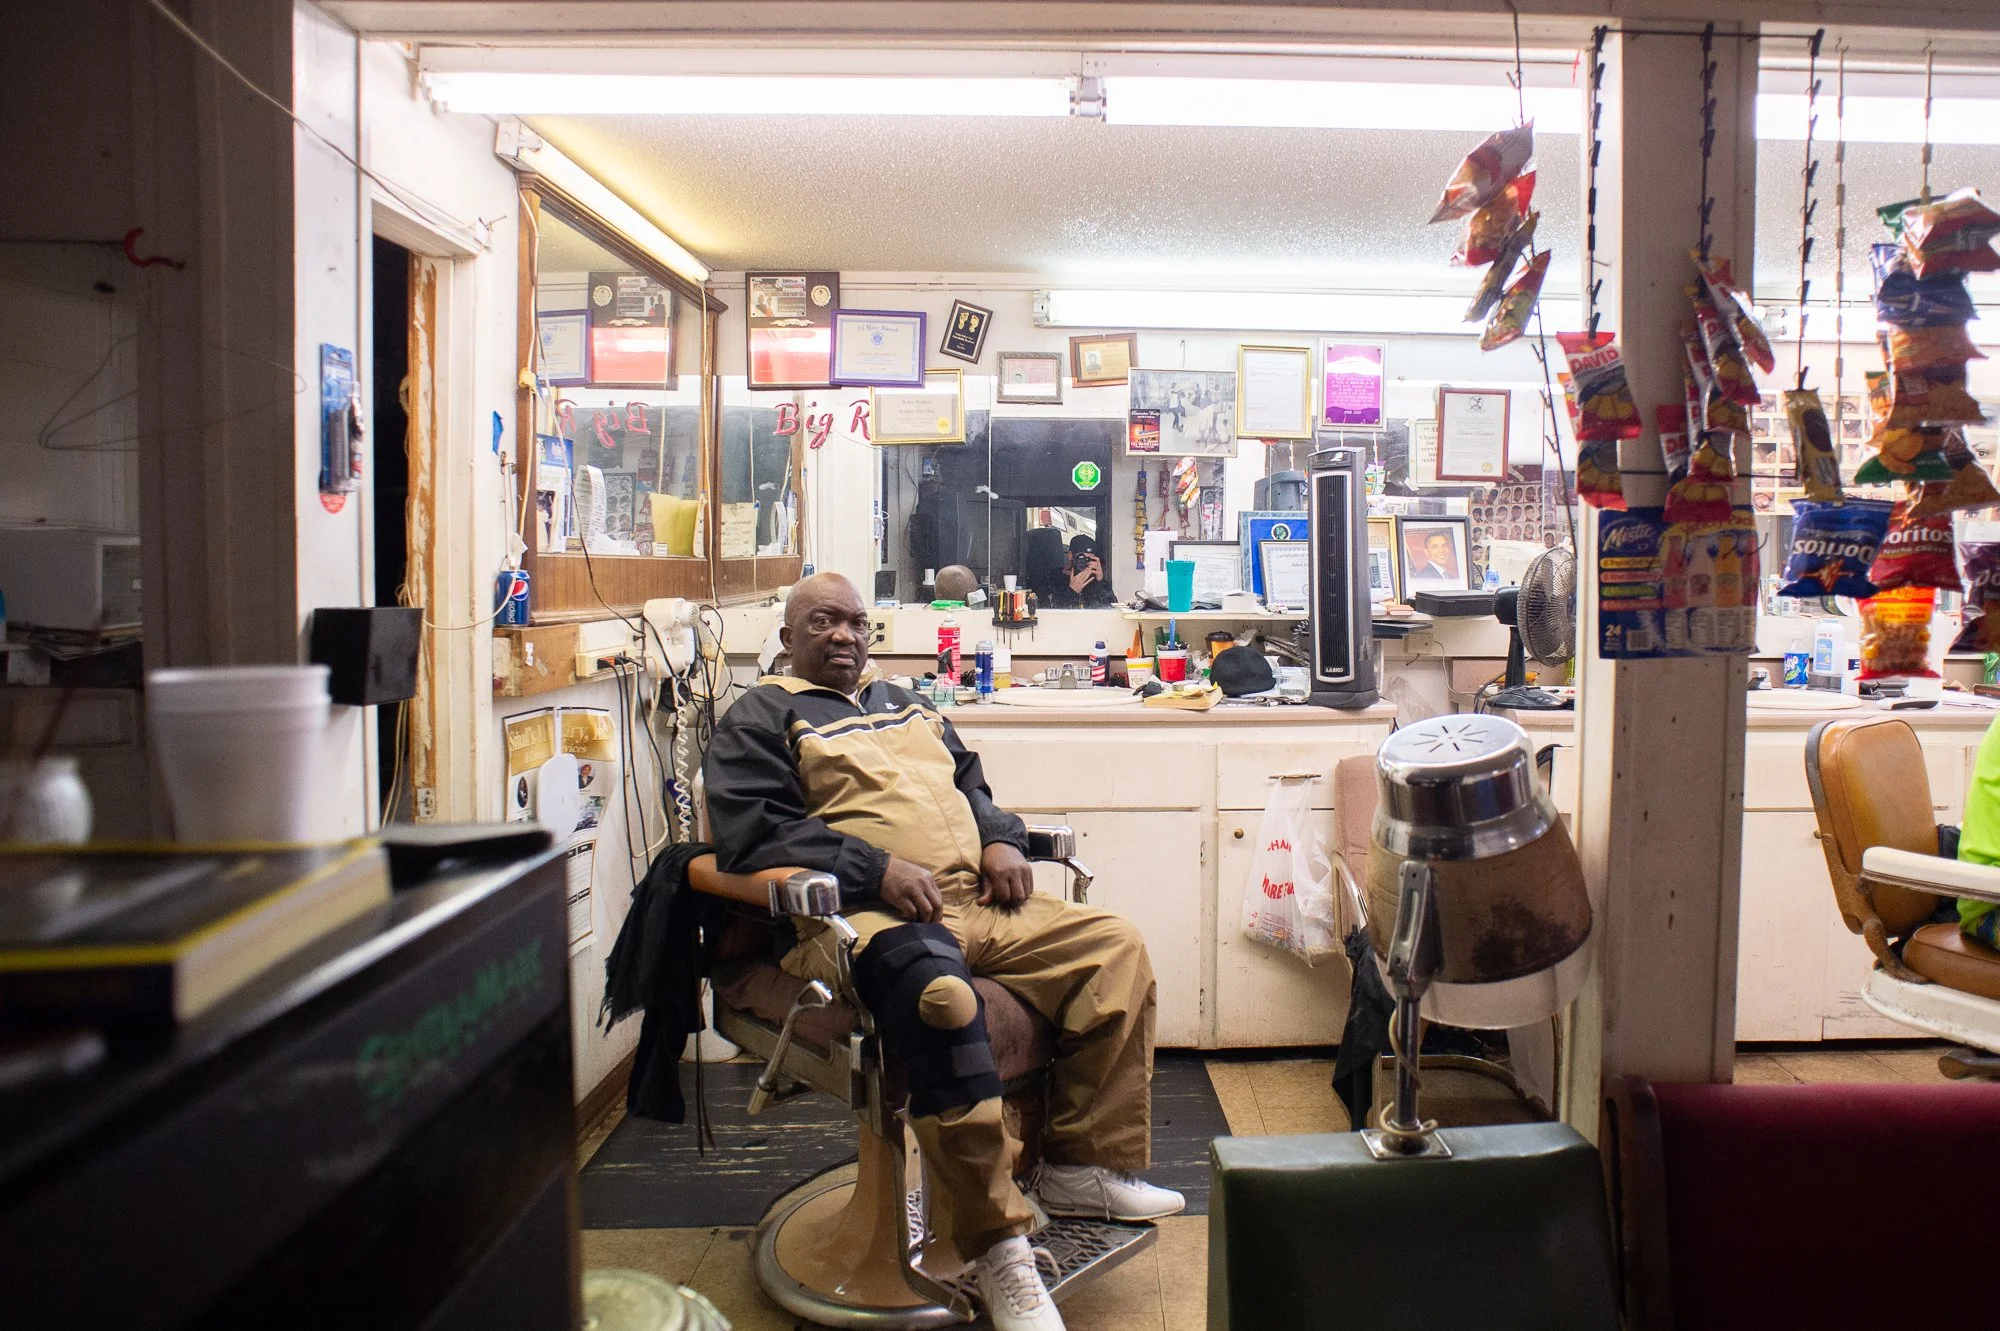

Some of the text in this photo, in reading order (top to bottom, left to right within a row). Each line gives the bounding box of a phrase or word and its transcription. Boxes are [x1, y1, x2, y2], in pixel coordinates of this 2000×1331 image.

[1570, 348, 1619, 374] DAVID
[773, 402, 833, 450] Big
[1884, 525, 1953, 544] oritos
[1792, 539, 1876, 565] Doritos
[508, 600, 517, 624] pepsi
[1605, 624, 1621, 637] 24
